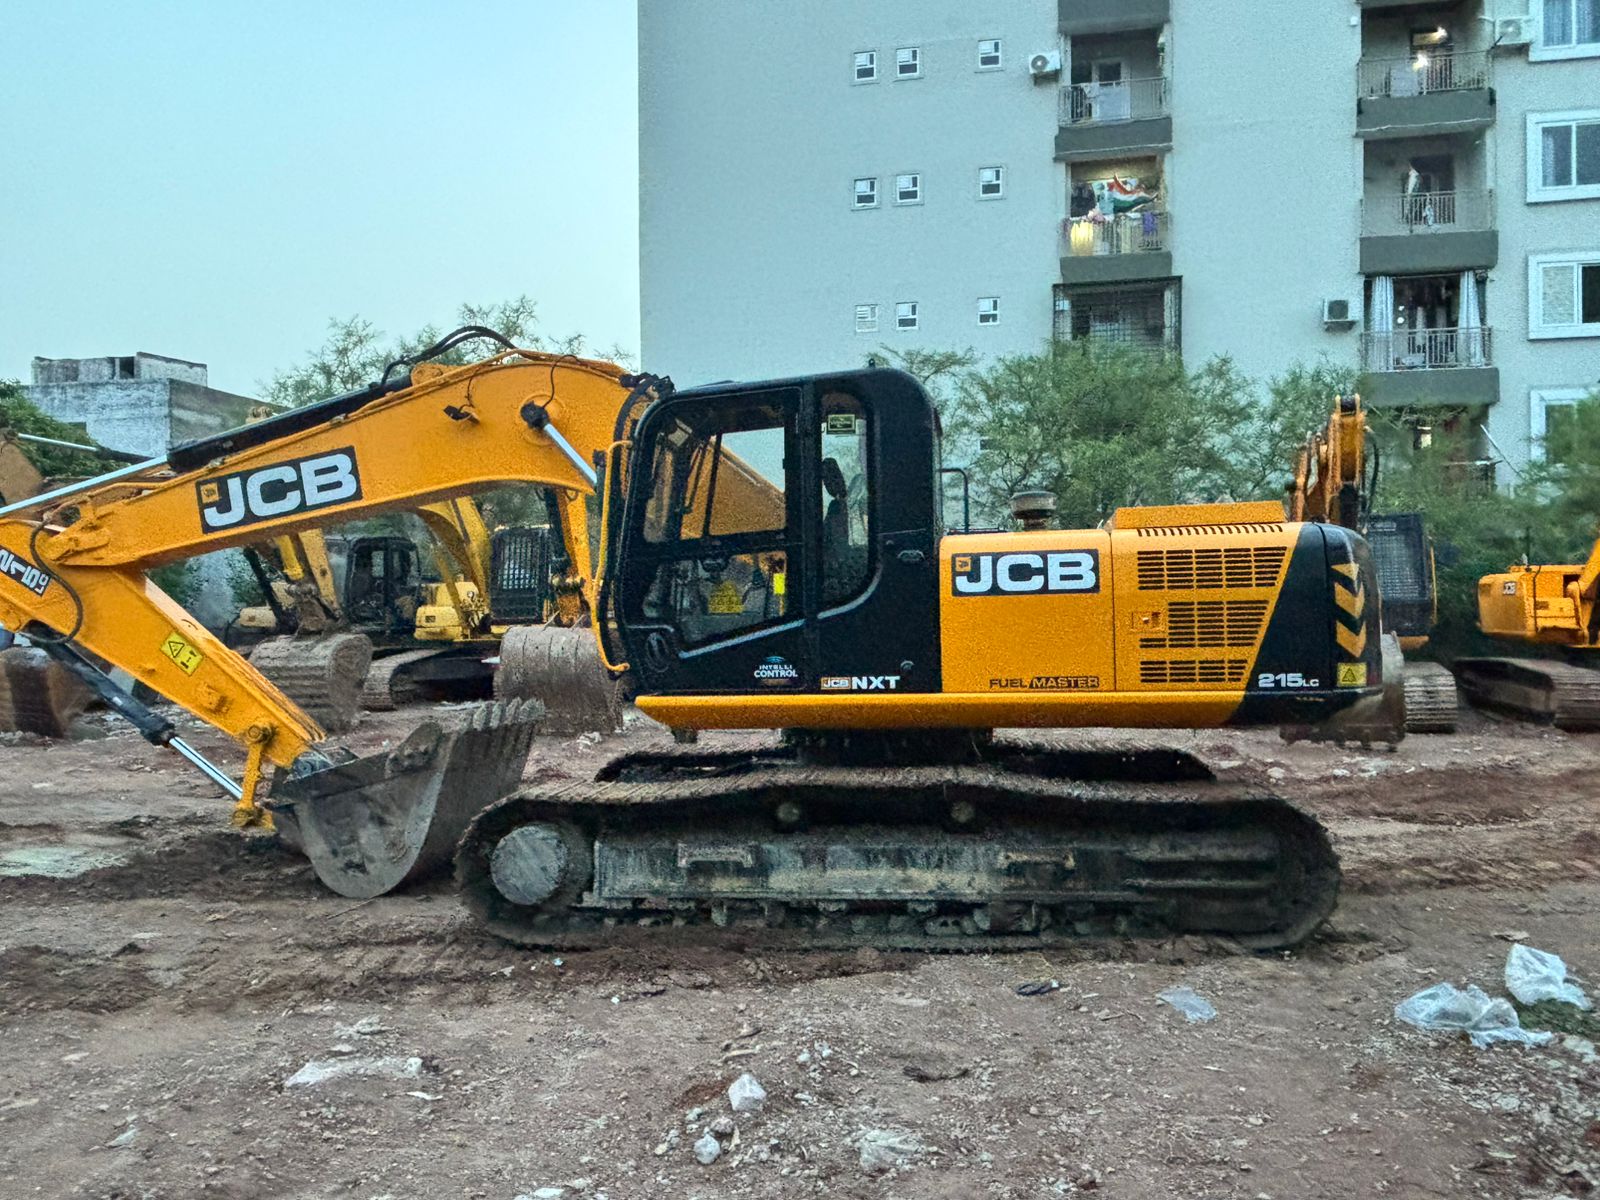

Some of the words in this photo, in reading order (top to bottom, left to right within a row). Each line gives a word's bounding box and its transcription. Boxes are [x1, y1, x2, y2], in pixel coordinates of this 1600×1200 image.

[204, 453, 357, 527] JCB
[955, 552, 1096, 593] JCB
[754, 669, 798, 678] CONTROL
[823, 677, 849, 688] JCB
[851, 675, 900, 690] NXT
[990, 678, 1028, 688] FUEL
[1032, 677, 1100, 688] MASTER
